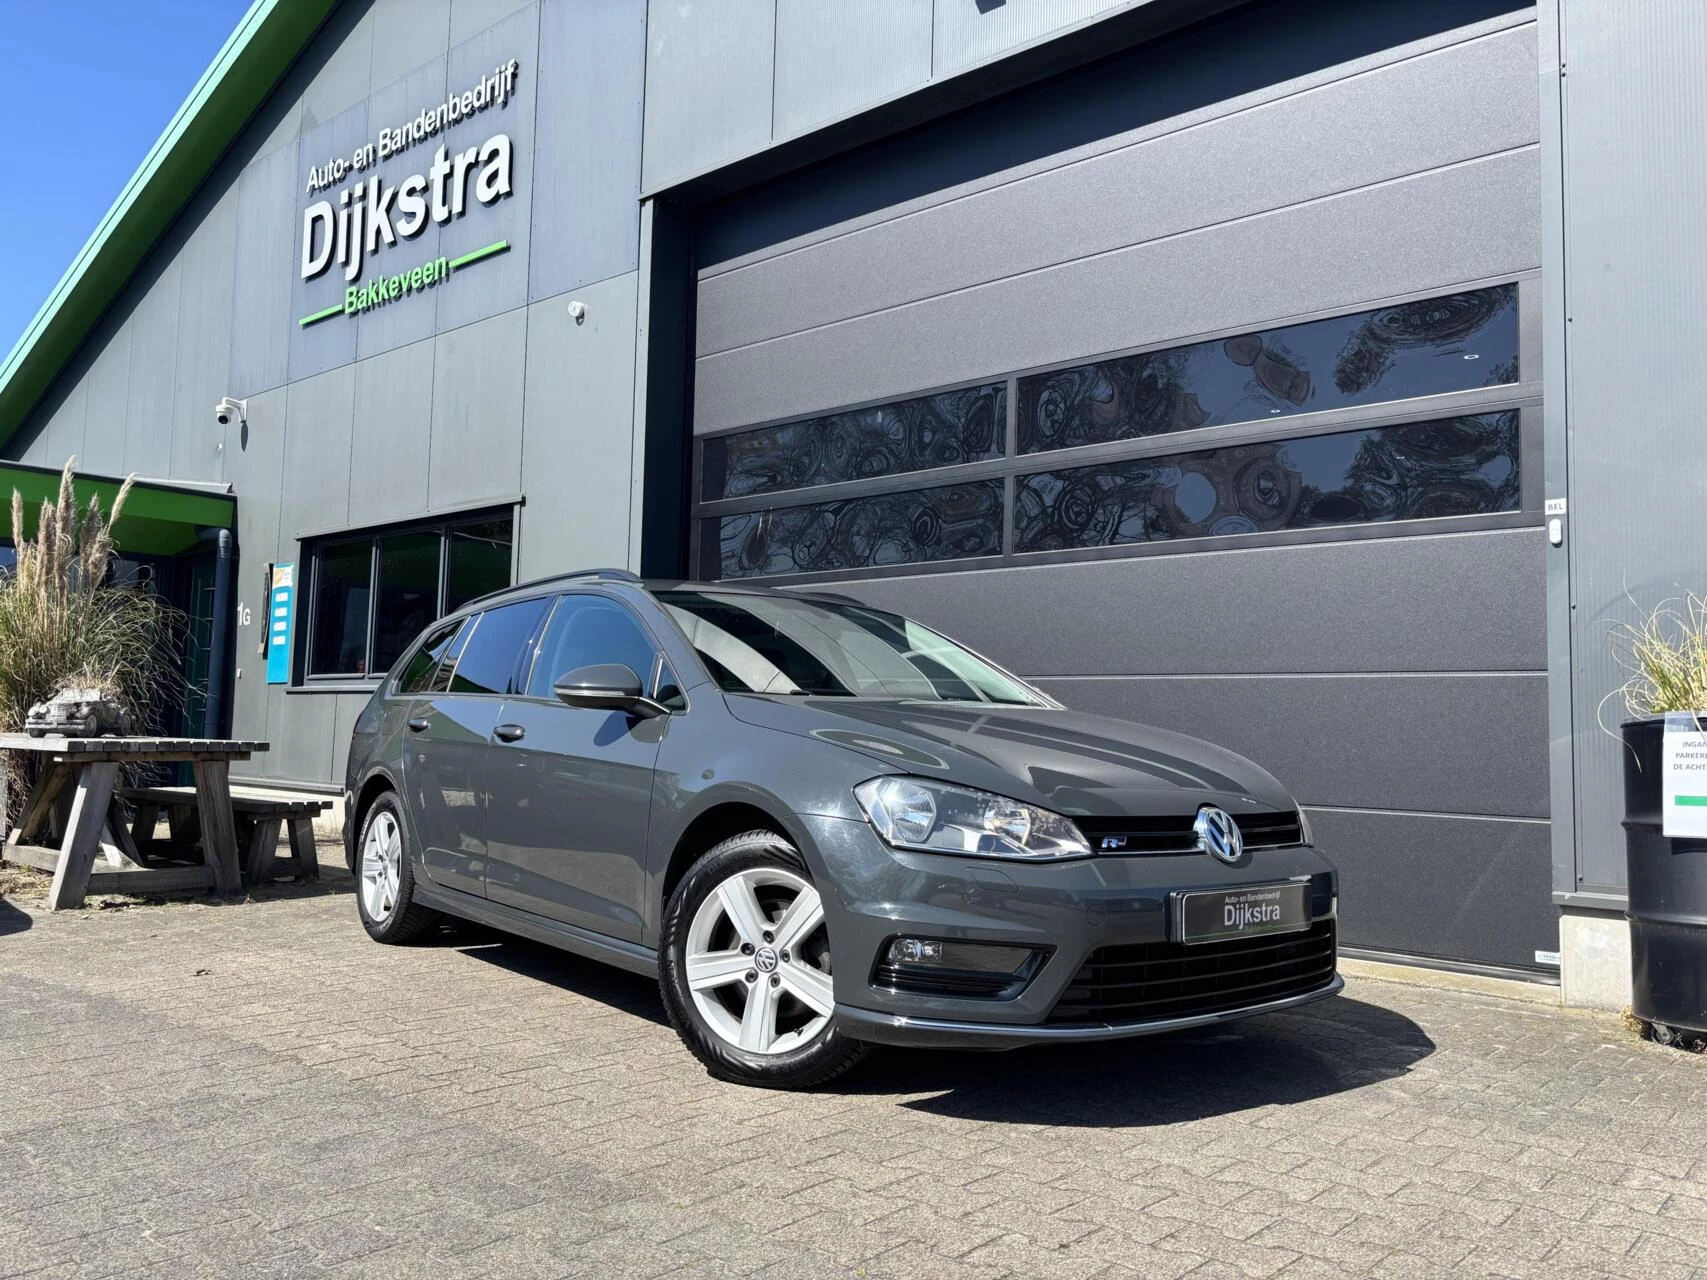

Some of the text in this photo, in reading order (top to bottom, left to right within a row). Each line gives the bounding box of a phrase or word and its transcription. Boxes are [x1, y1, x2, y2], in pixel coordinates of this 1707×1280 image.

[306, 58, 518, 193] Auto- en Bandenbedrijf
[301, 133, 512, 281] Dijkstra
[344, 256, 448, 315] Bakkeveen
[1547, 503, 1563, 511] BEL
[1224, 903, 1280, 930] Dijkstra
